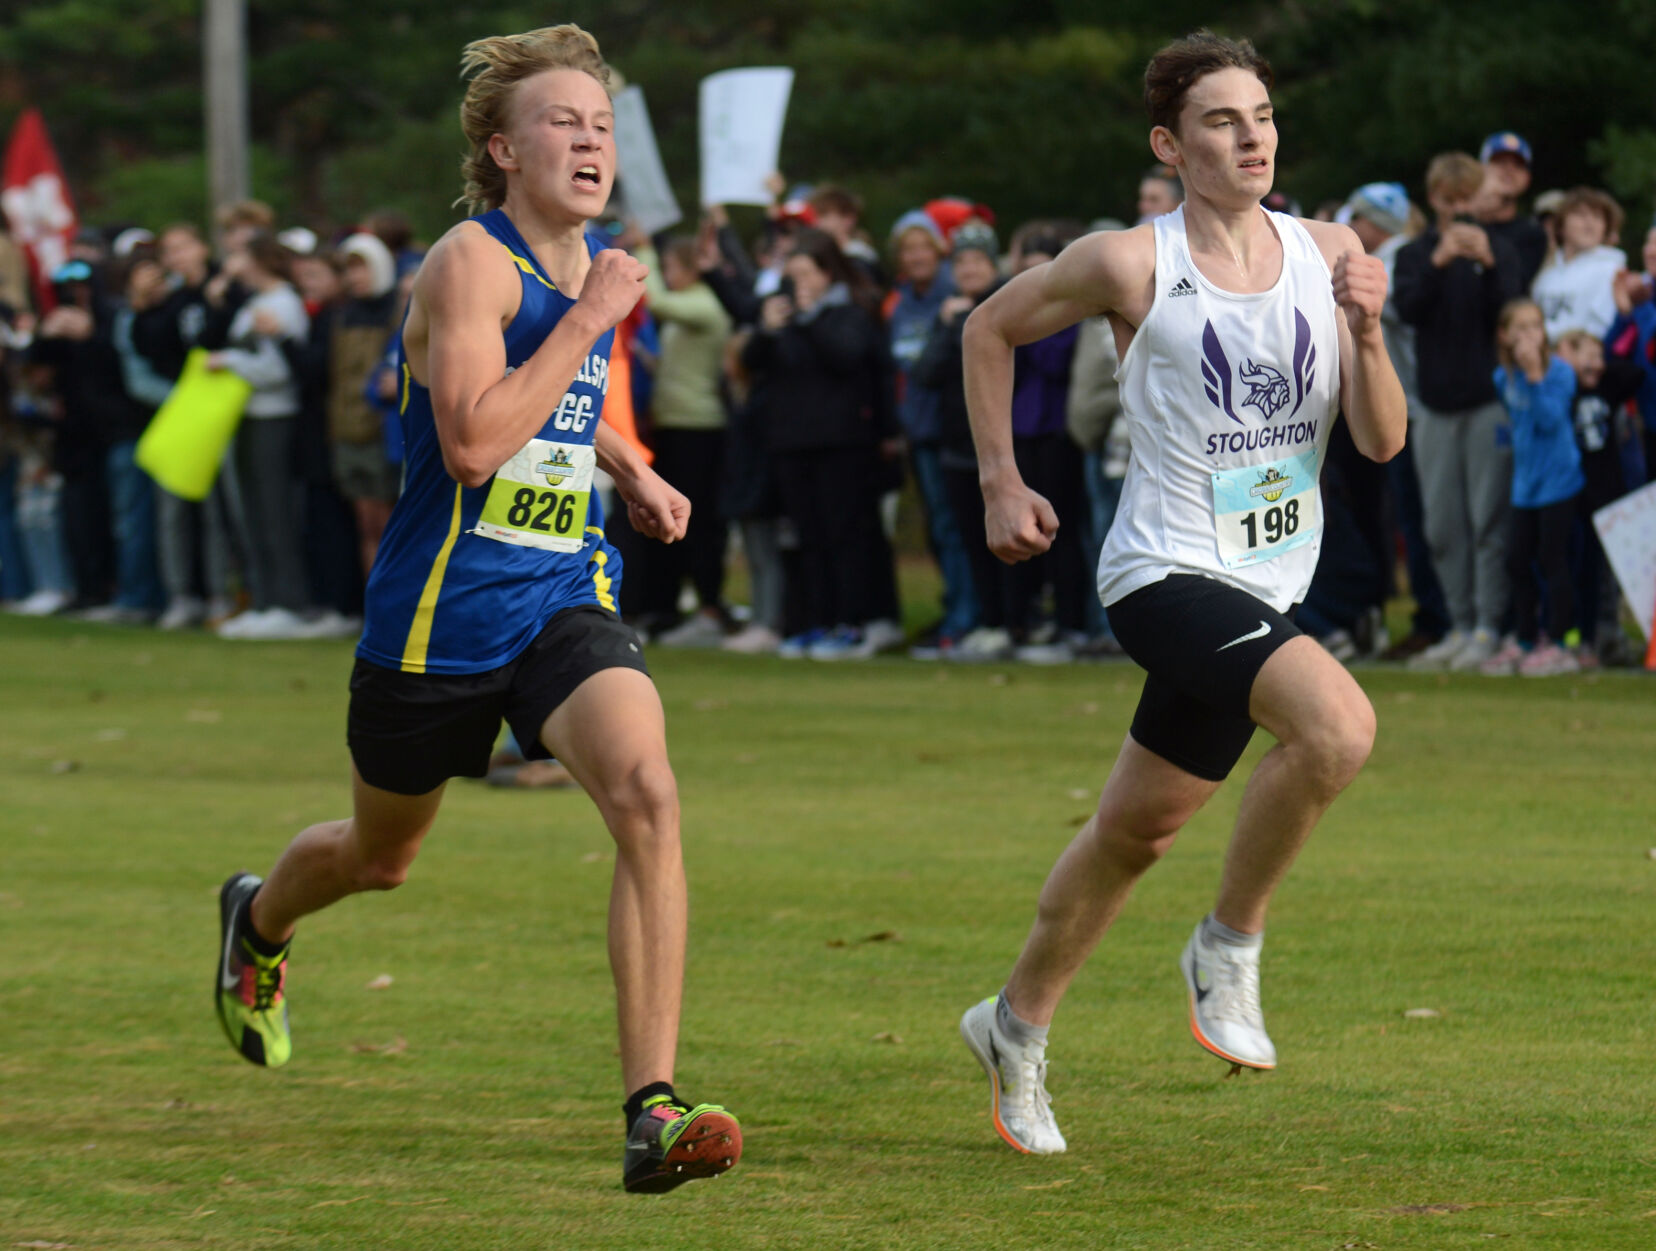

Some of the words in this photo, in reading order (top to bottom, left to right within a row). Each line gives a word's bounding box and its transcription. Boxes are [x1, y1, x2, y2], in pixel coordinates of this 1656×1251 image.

[1168, 288, 1198, 298] adidas
[553, 392, 593, 433] CC
[1206, 419, 1318, 455] STOUGHTON
[507, 487, 576, 534] 826
[1240, 498, 1299, 549] 198
